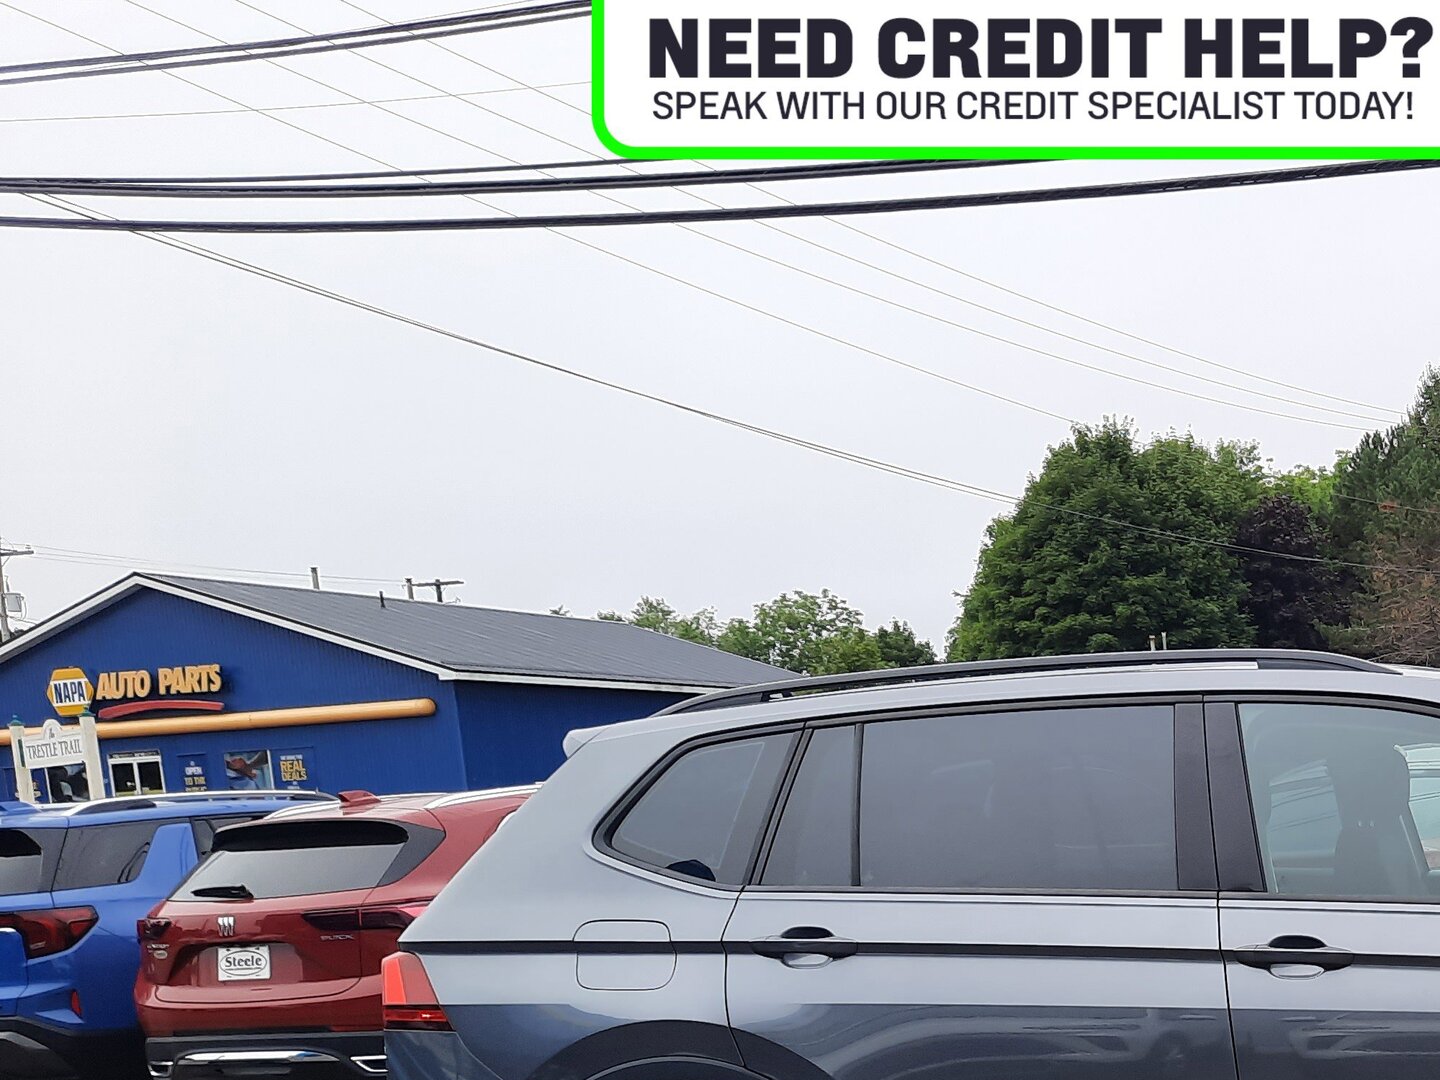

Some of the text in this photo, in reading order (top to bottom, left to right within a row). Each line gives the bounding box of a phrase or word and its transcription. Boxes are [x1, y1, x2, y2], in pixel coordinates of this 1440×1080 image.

[53, 664, 222, 704] NAPA AUTO PARTS
[26, 738, 83, 760] TRESTLE TRAIL
[280, 760, 306, 772] REAL
[281, 769, 308, 781] DEALS
[225, 955, 262, 968] Steele
